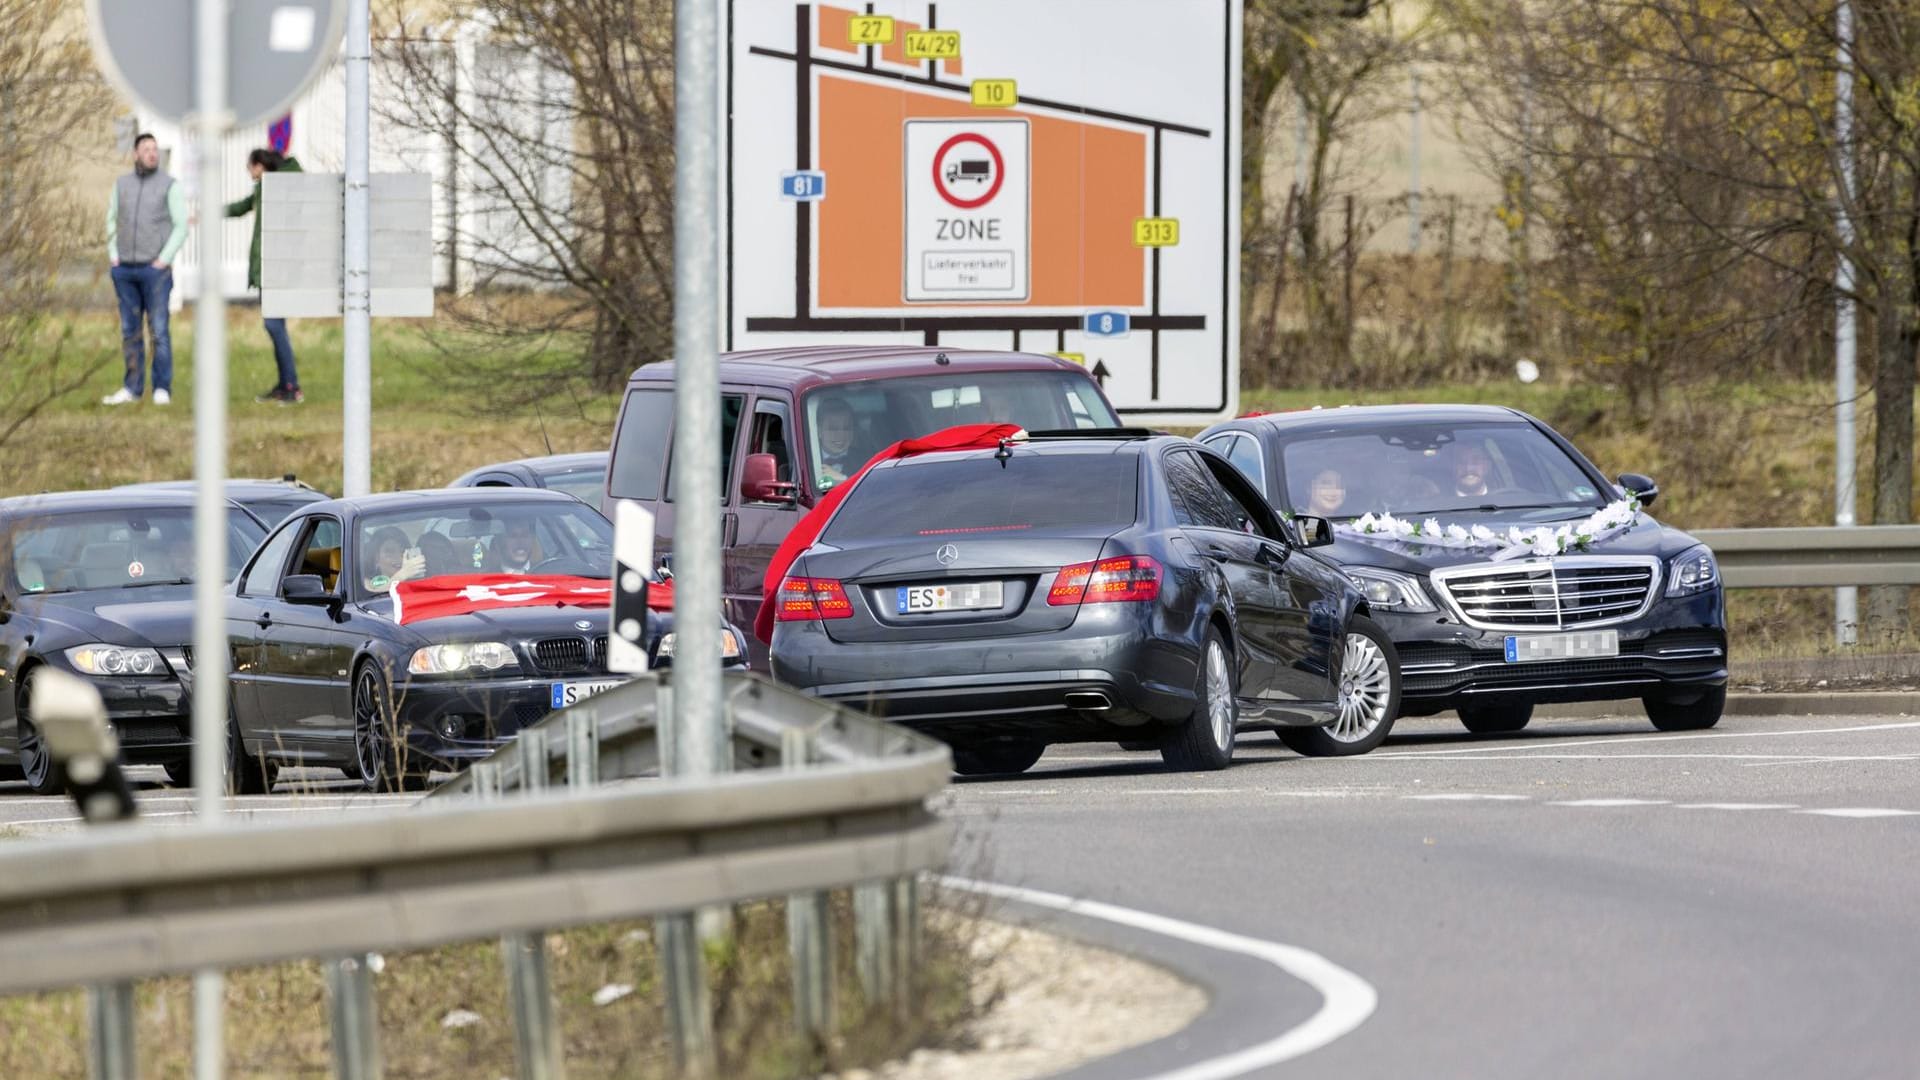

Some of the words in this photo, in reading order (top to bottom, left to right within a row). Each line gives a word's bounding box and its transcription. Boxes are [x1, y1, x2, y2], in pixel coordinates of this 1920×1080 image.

[861, 21, 882, 38] 27
[908, 36, 957, 53] 14/29
[985, 84, 1004, 101] 10
[793, 176, 812, 195] 81
[936, 218, 1001, 240] ZONE
[1143, 223, 1172, 241] 313
[1101, 314, 1112, 333] 8
[909, 589, 934, 608] ES
[565, 686, 577, 704] S
